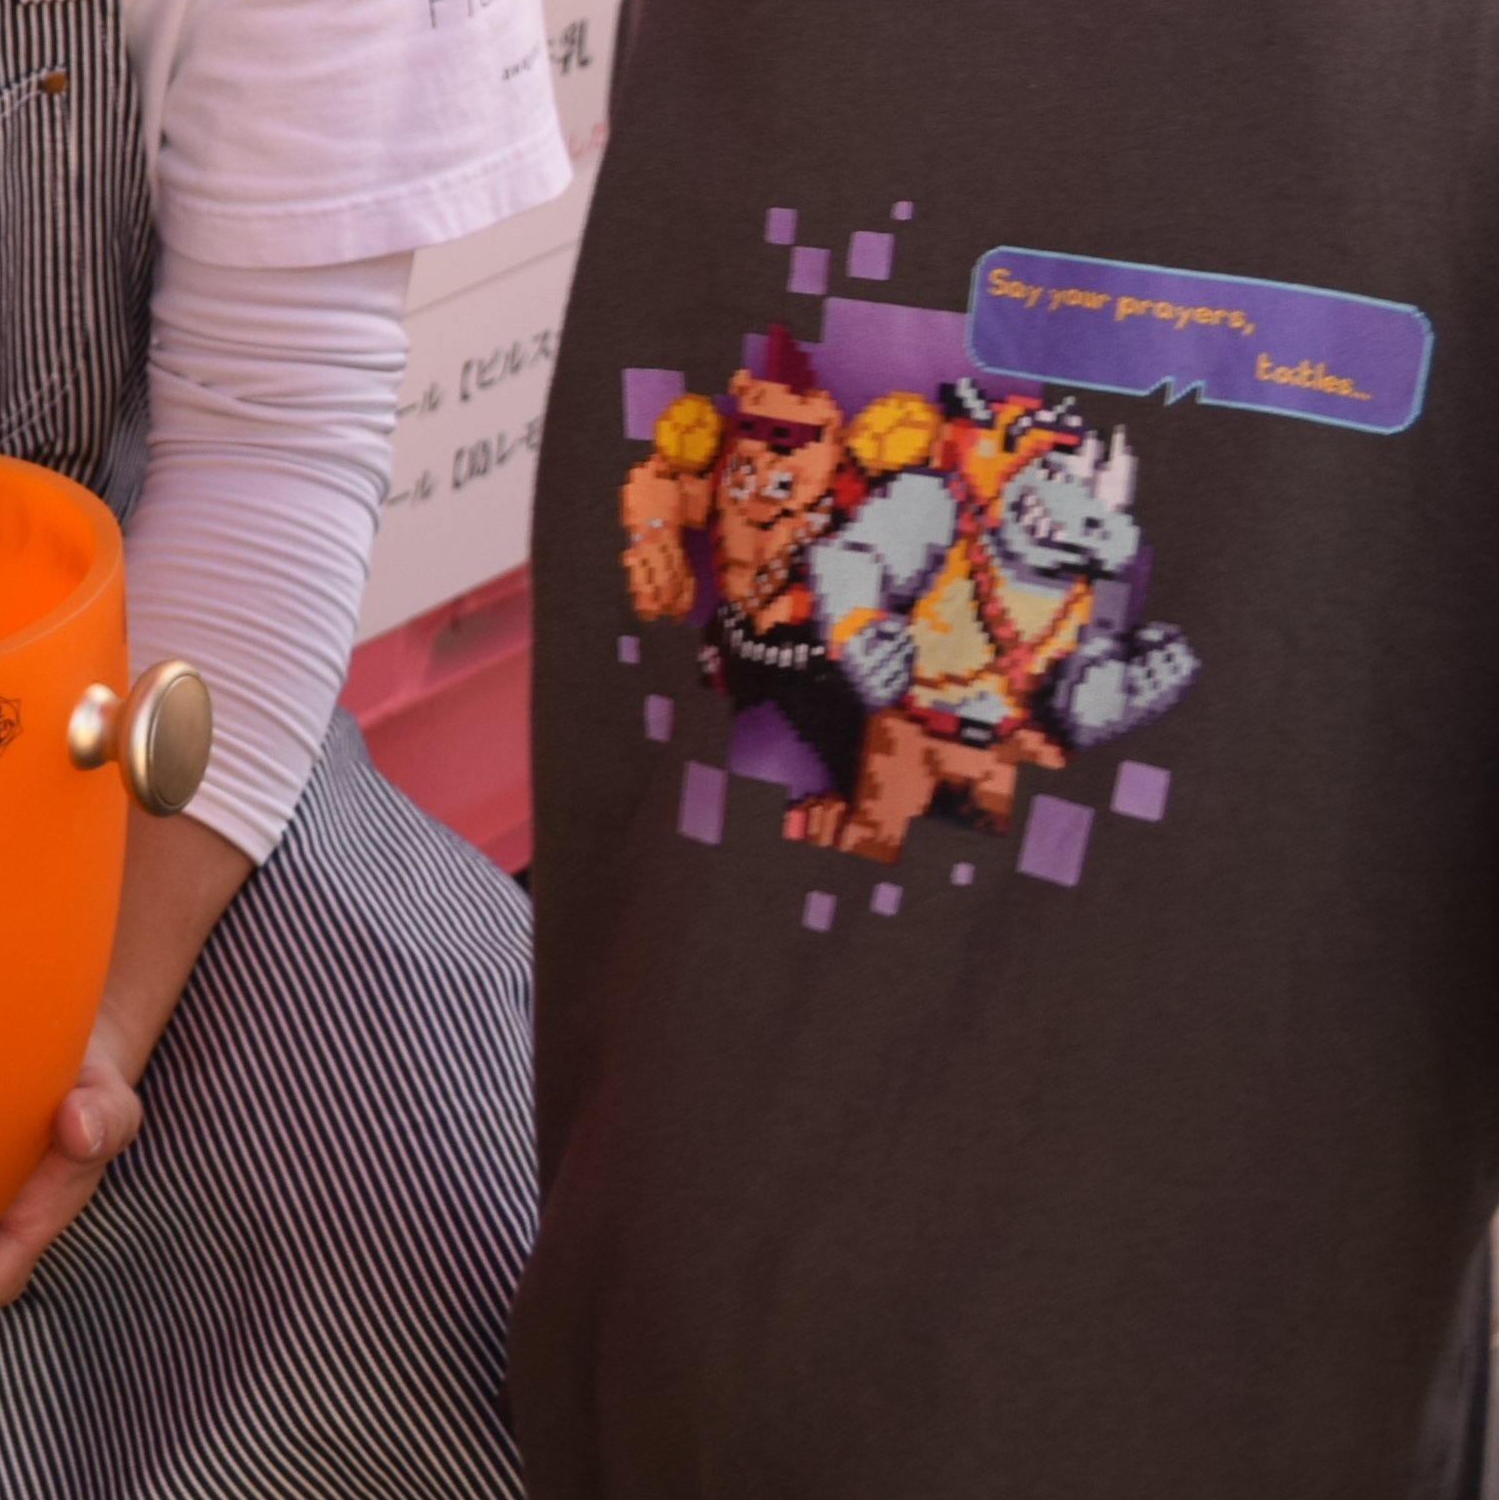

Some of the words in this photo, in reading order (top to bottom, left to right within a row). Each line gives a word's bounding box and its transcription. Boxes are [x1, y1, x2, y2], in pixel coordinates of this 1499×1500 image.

[987, 267, 1044, 310] Say
[1048, 287, 1113, 313] your
[1114, 295, 1258, 337] prayers,
